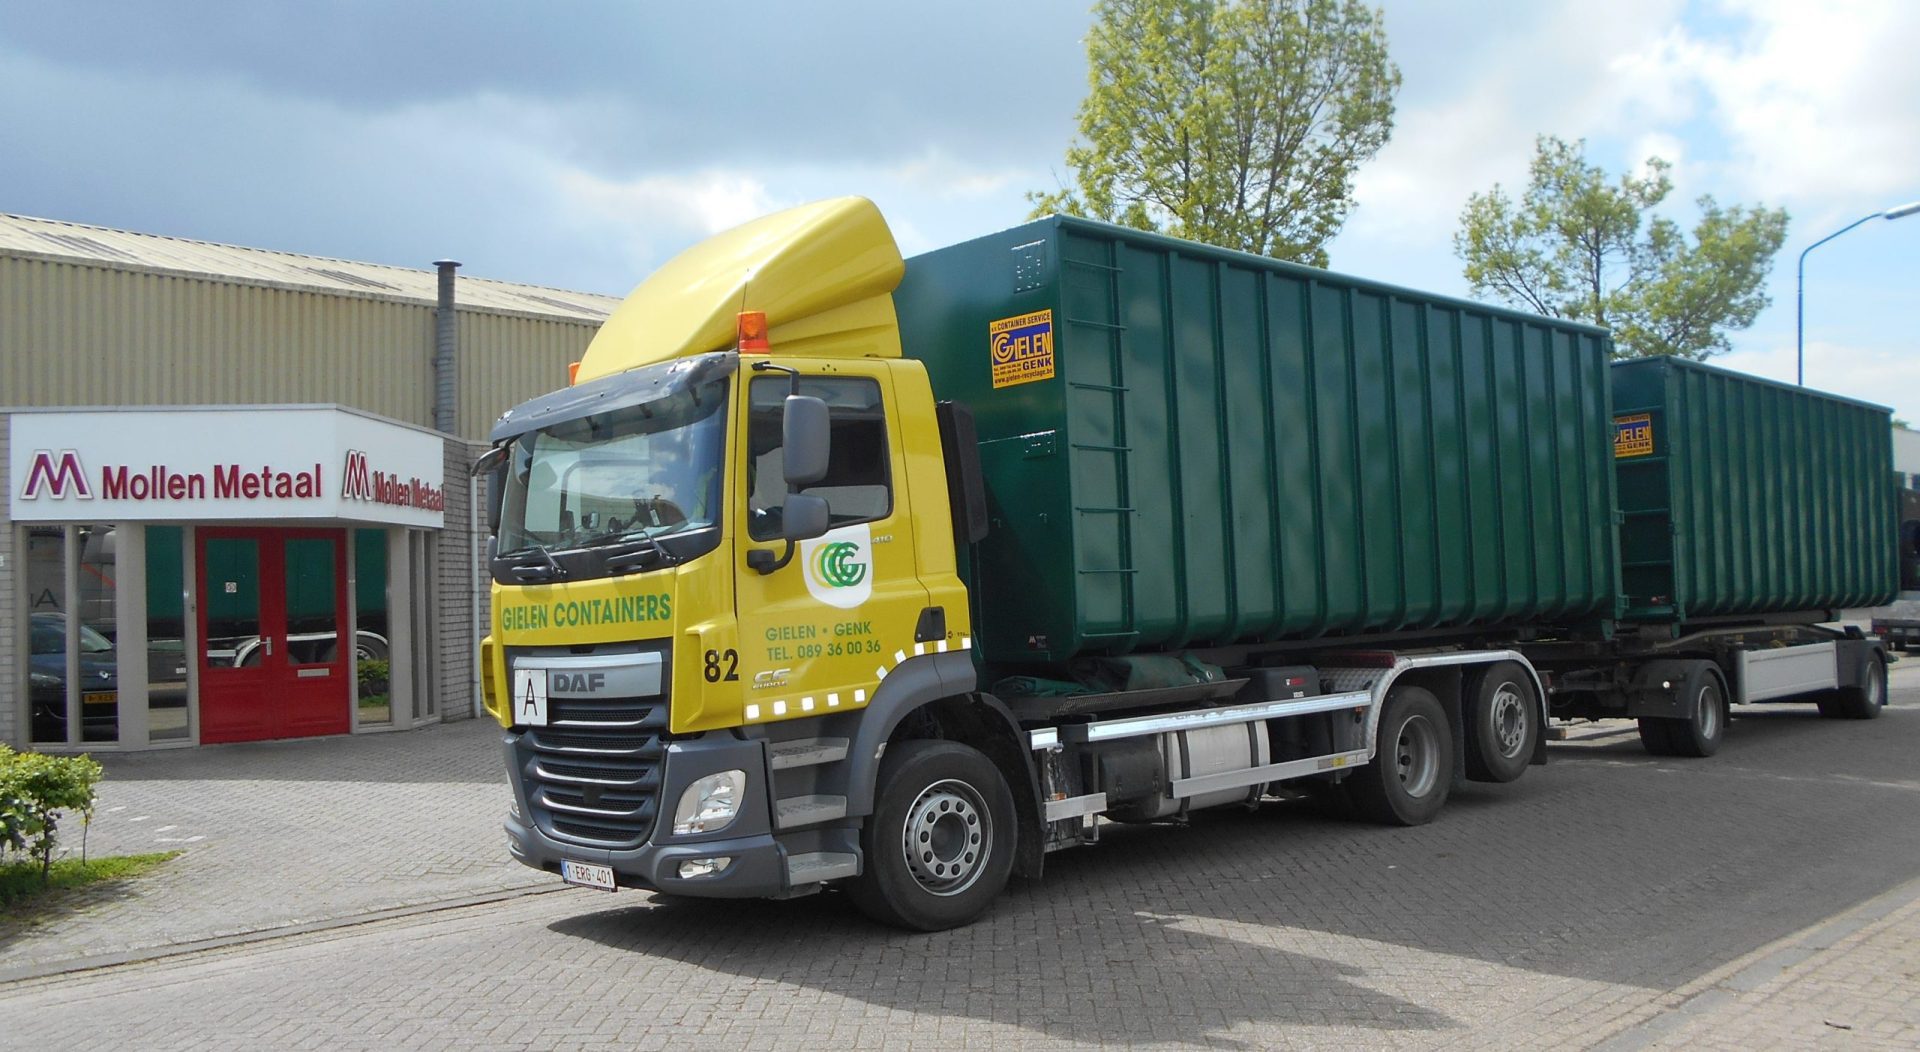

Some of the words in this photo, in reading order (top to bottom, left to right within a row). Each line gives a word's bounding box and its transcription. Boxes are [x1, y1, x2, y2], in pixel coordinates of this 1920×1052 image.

[998, 318, 1026, 330] CONTAINER
[1027, 312, 1050, 324] SERVICE
[993, 332, 1051, 363] GIELEN
[1023, 357, 1052, 370] GENK
[1614, 426, 1650, 443] IELEN
[102, 464, 205, 500] Mollen
[213, 462, 322, 499] Metaal
[373, 470, 410, 506] Mollen
[411, 477, 444, 511] Metaal
[502, 604, 548, 631] GIELEN
[553, 593, 672, 628] CONTAINERS
[765, 625, 816, 641] GIELEN
[834, 621, 872, 637] GENK
[767, 647, 793, 661] TEL.
[797, 644, 822, 659] 089
[827, 642, 843, 657] 36
[847, 640, 862, 655] 00
[866, 639, 881, 653] 36
[704, 648, 739, 683] 82
[553, 673, 605, 692] DAF
[523, 677, 538, 716] A
